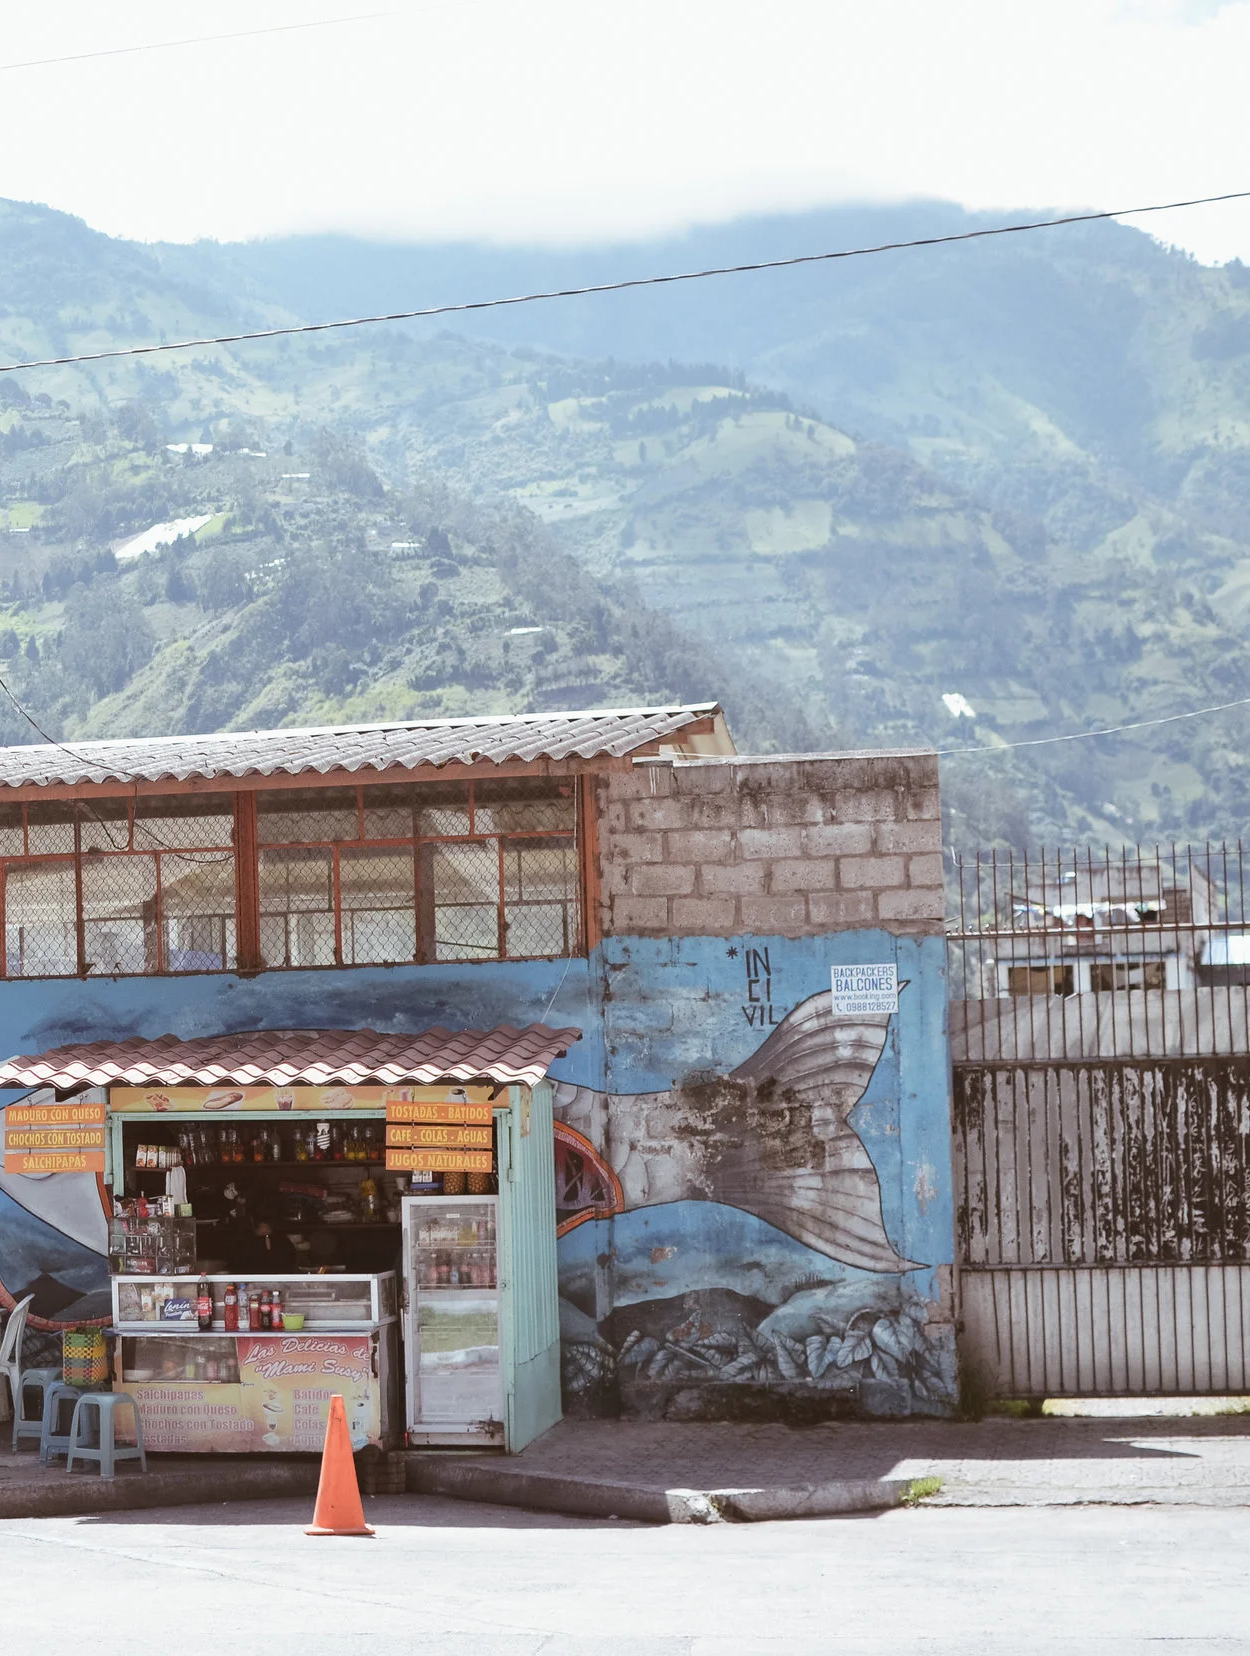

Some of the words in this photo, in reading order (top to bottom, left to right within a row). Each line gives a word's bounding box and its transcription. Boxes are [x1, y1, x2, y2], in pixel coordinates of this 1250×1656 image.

[745, 946, 771, 978] IN
[833, 966, 894, 978] BACKPACKERS
[836, 977, 893, 992] BALCONES
[834, 993, 896, 1001] www.booking.com
[846, 1001, 896, 1012] 0988128527
[741, 1004, 779, 1026] VIL
[8, 1109, 48, 1121] MADURO
[50, 1109, 69, 1121] CON
[71, 1108, 101, 1120] QUESO
[390, 1105, 438, 1119] TOSTADAS
[448, 1107, 489, 1119] BATIDOS
[8, 1133, 46, 1146] CHOCHOS
[47, 1132, 65, 1145] CON
[66, 1132, 102, 1144] TOSTADO
[390, 1129, 411, 1142] CAFE
[420, 1130, 448, 1142] COLAS
[457, 1130, 488, 1143] AGUAS
[22, 1155, 87, 1169] SALCHIPAPAS
[389, 1153, 424, 1167] JUGOS
[427, 1154, 488, 1168] NATURALES
[243, 1343, 276, 1365] Las
[281, 1337, 348, 1355] Delicias
[352, 1346, 370, 1361] de
[136, 1389, 205, 1401] Salchipapas
[180, 1405, 201, 1415] con
[203, 1404, 237, 1415] Queso
[186, 1420, 206, 1430] con
[210, 1419, 255, 1431] Tostado
[143, 1434, 187, 1445] ostadas
[294, 1434, 325, 1446] Agua
